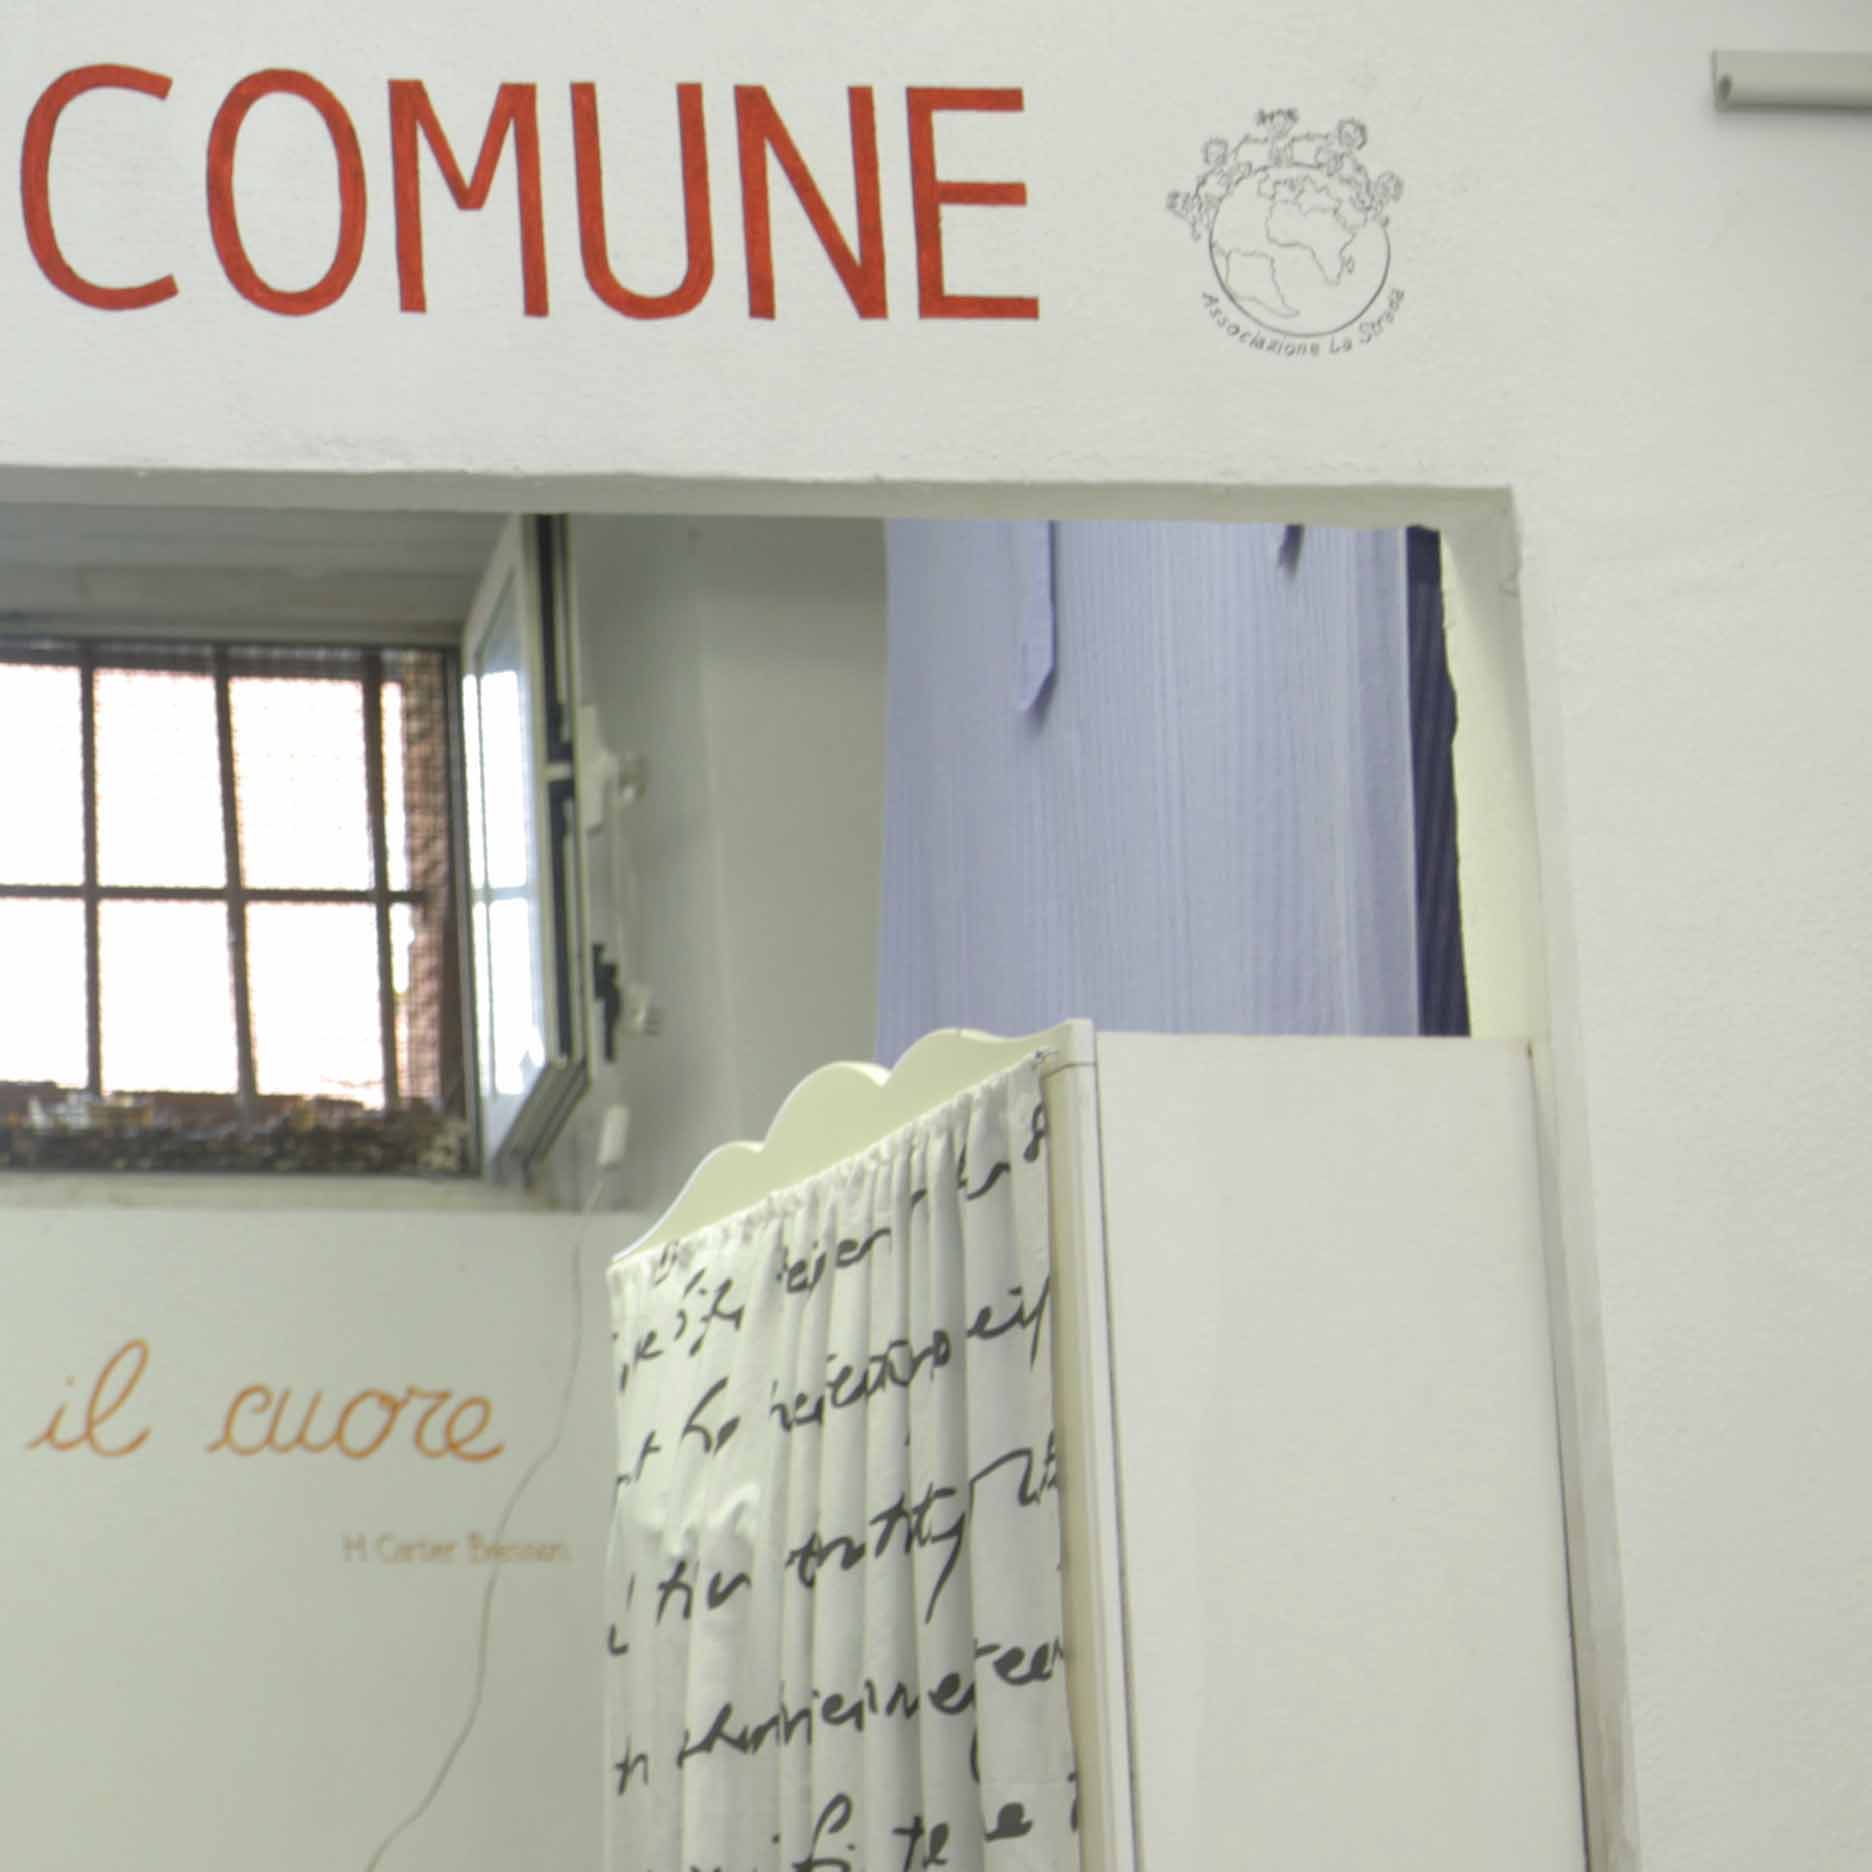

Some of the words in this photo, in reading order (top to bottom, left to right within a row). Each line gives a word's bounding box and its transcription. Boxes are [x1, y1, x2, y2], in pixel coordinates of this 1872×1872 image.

[20, 61, 1042, 321] COMUNE
[28, 1337, 153, 1458] il
[207, 1383, 506, 1463] cuore
